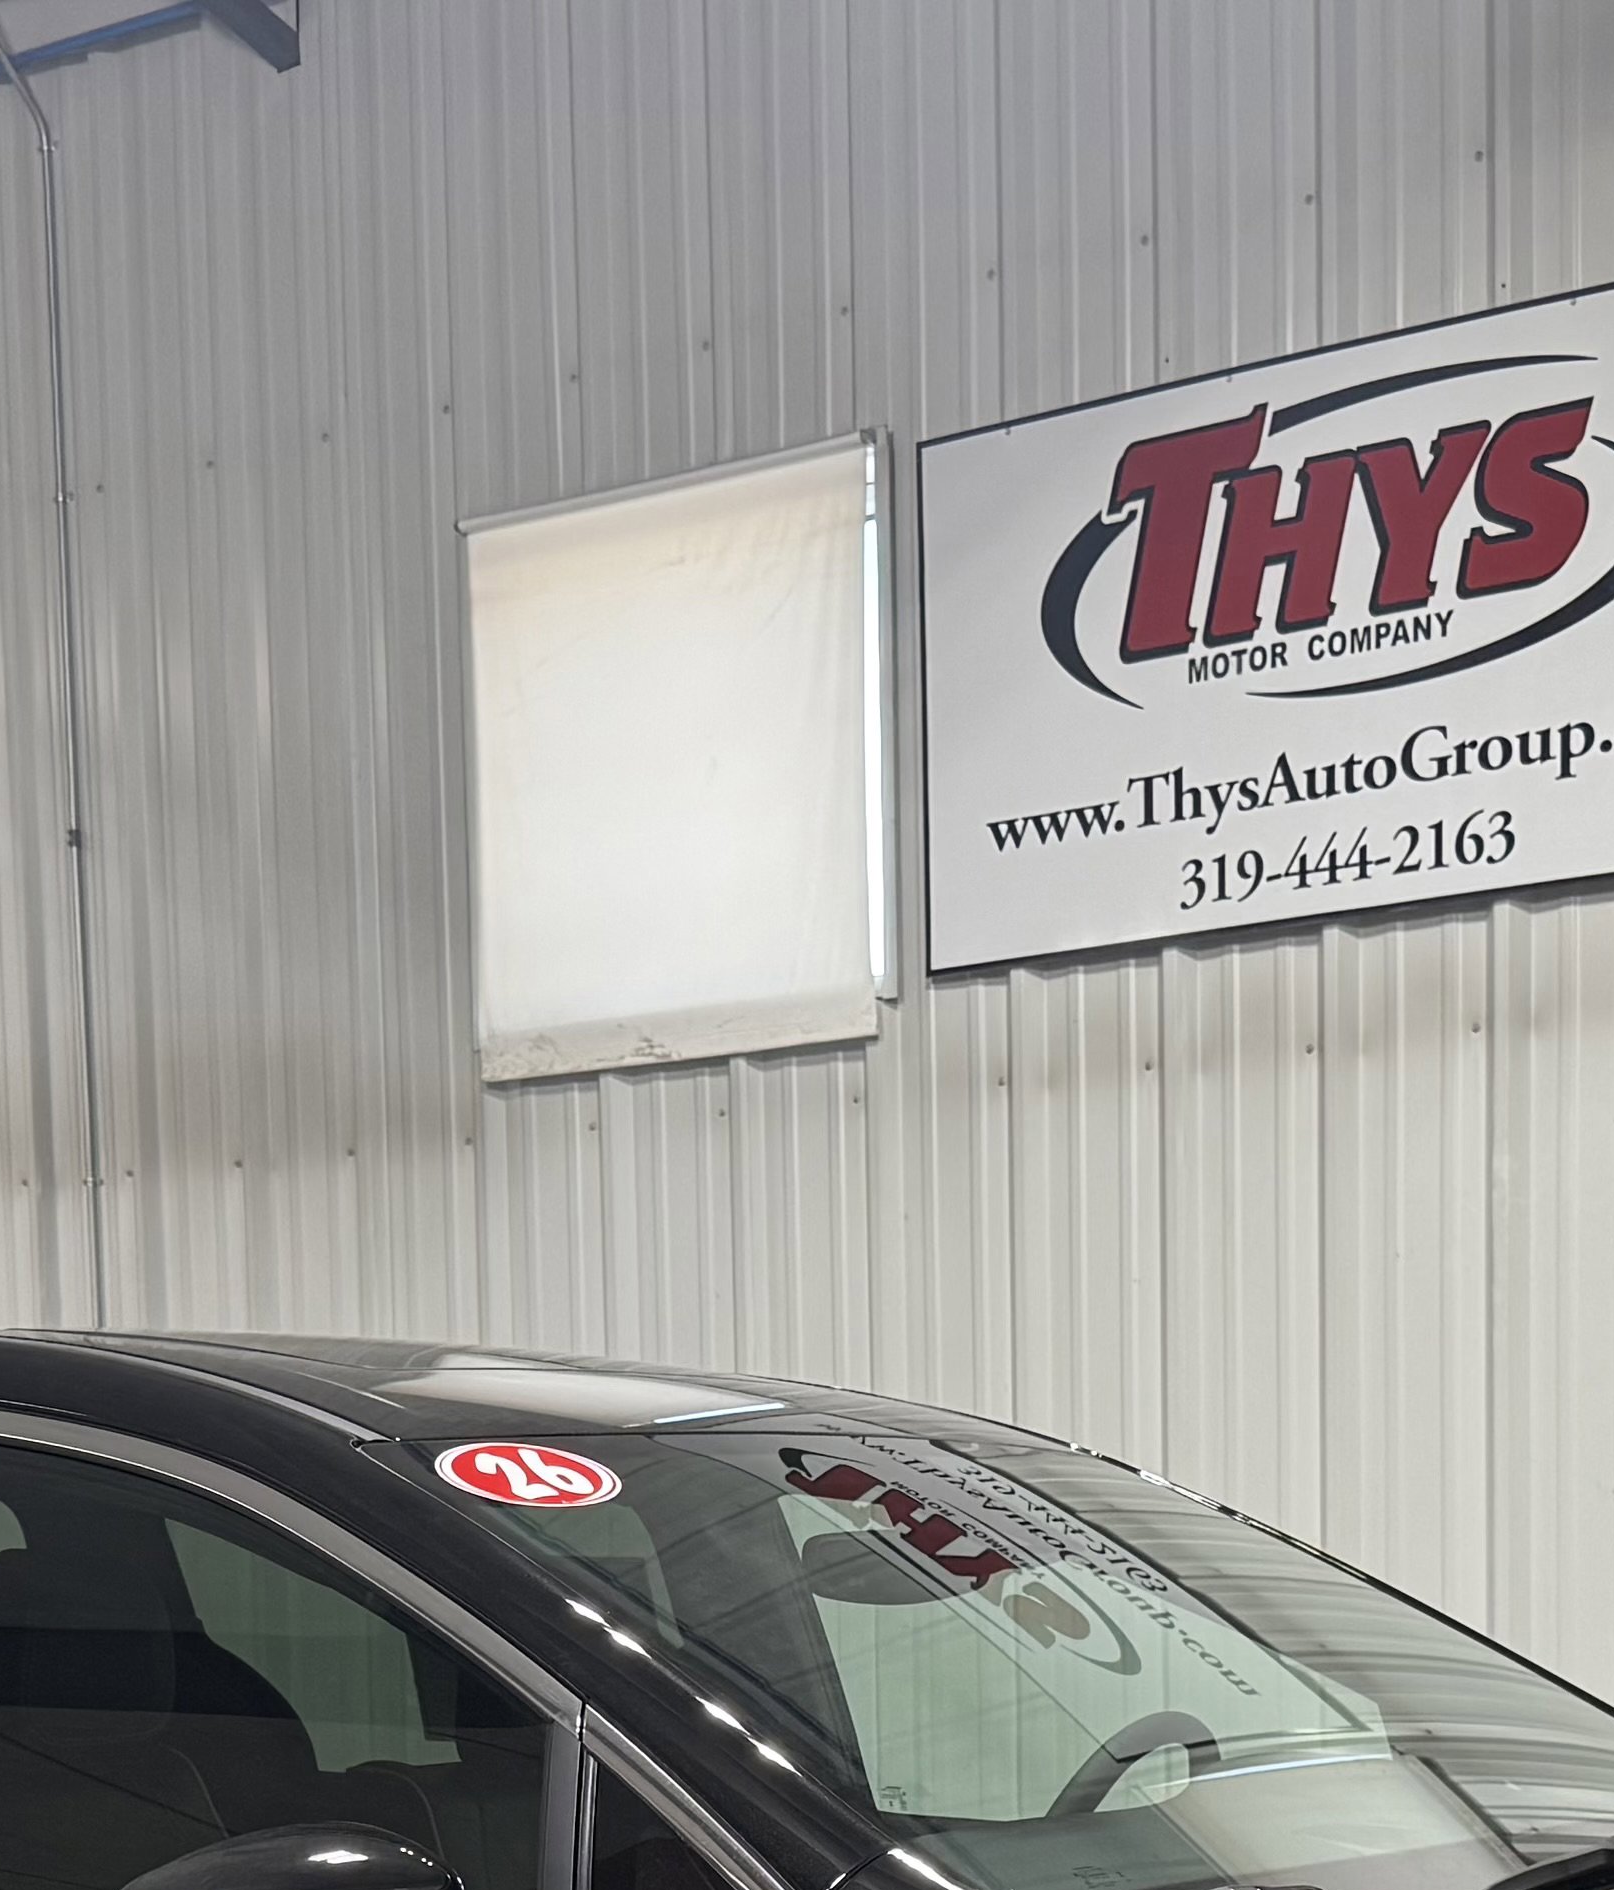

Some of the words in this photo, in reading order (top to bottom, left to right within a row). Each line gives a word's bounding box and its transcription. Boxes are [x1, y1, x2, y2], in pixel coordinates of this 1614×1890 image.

[1102, 396, 1594, 664] THYS
[1186, 641, 1289, 686] MOTOR
[1307, 609, 1456, 662] COMPANY
[1179, 809, 1517, 911] 319-444-2163
[474, 1448, 595, 1500] 26
